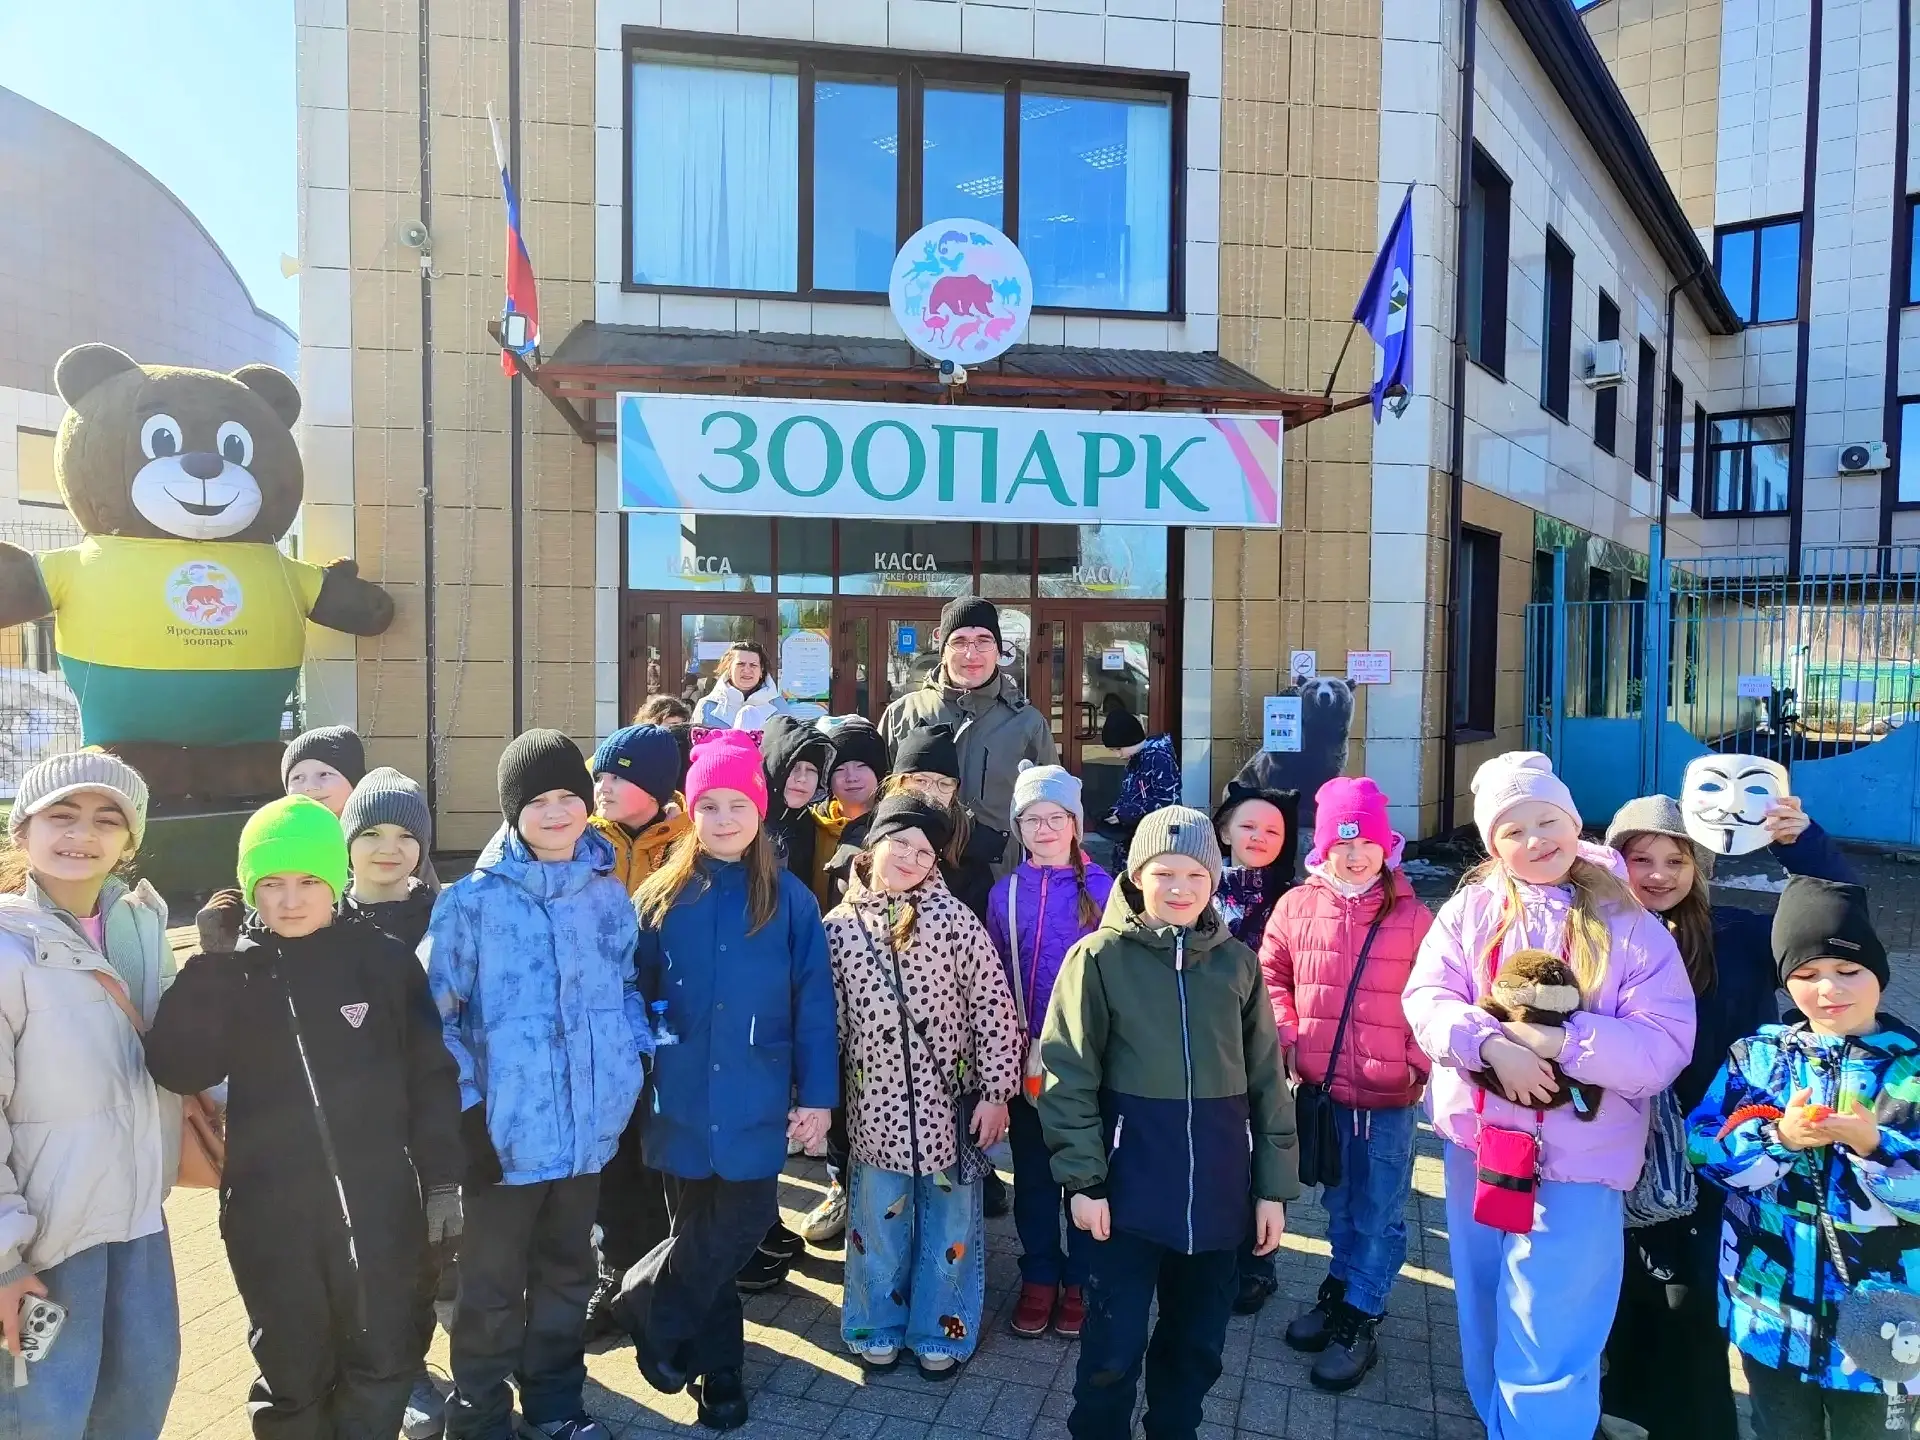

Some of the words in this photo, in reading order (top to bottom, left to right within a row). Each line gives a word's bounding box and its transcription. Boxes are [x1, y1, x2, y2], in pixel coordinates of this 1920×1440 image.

[698, 410, 1210, 512] ЗООПАРК
[874, 552, 938, 571] КАССА
[878, 572, 905, 581] TICKET
[166, 625, 248, 637] Ярославский
[183, 638, 235, 647] зоопарк
